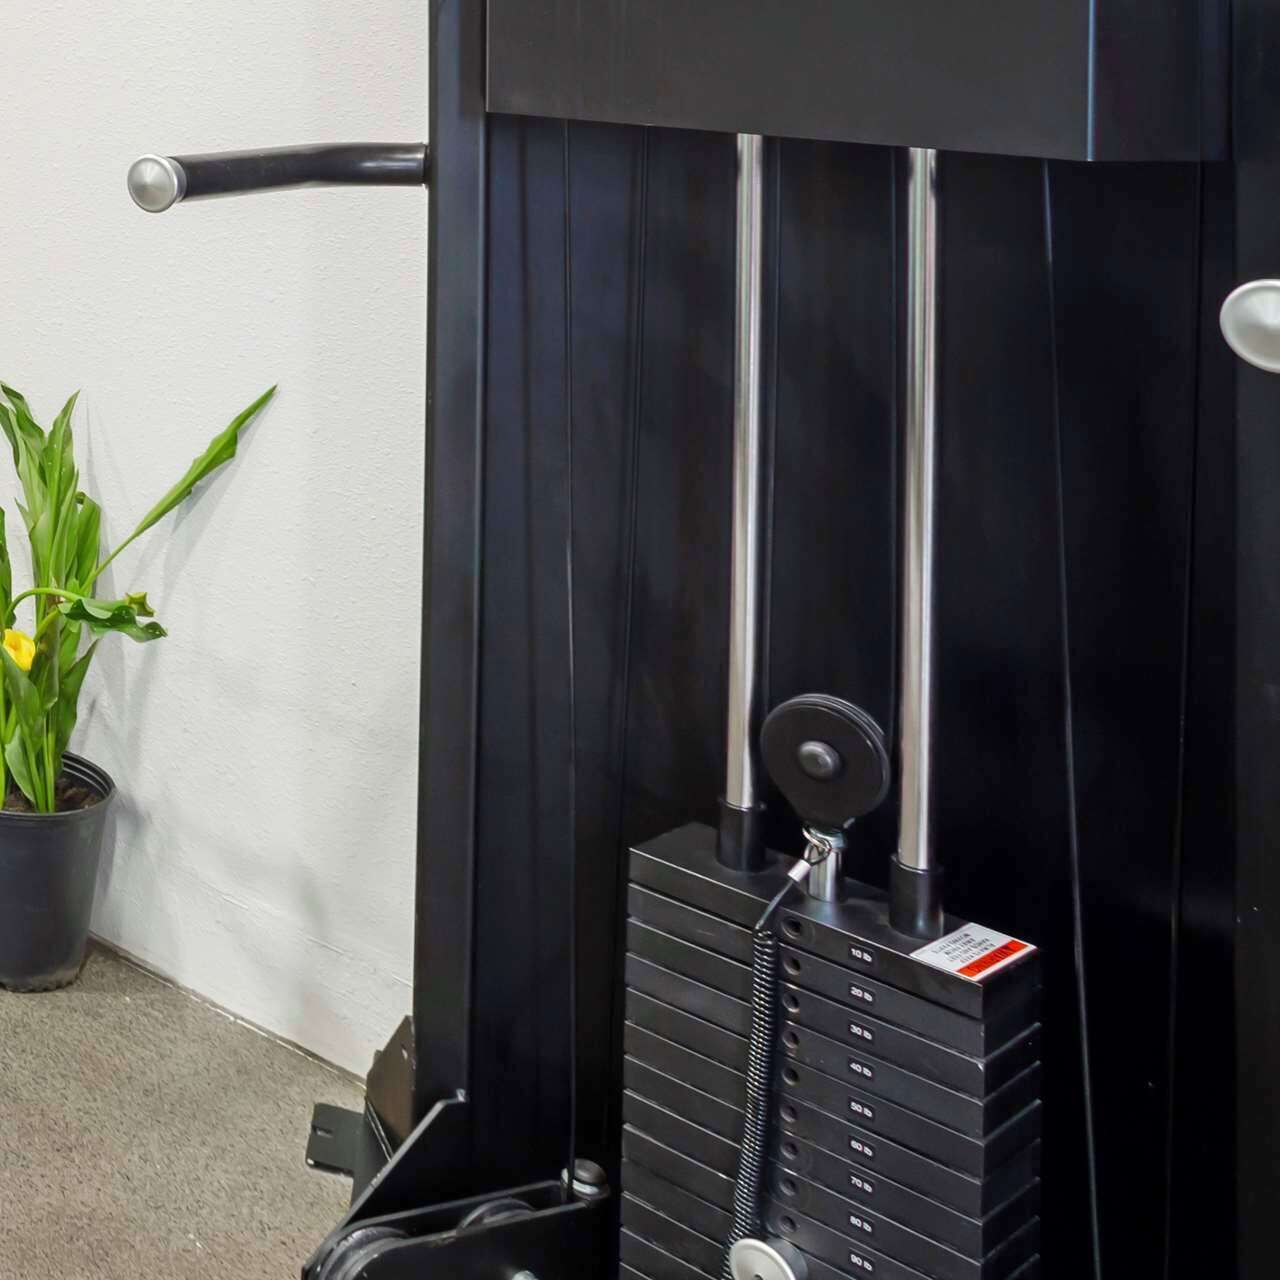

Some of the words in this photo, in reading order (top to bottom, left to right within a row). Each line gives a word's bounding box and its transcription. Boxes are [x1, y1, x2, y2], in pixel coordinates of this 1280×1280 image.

[851, 948, 862, 959] 10
[850, 986, 863, 997] 20
[850, 1024, 862, 1036] 30
[850, 1101, 863, 1113] 50
[851, 1176, 862, 1188] 70
